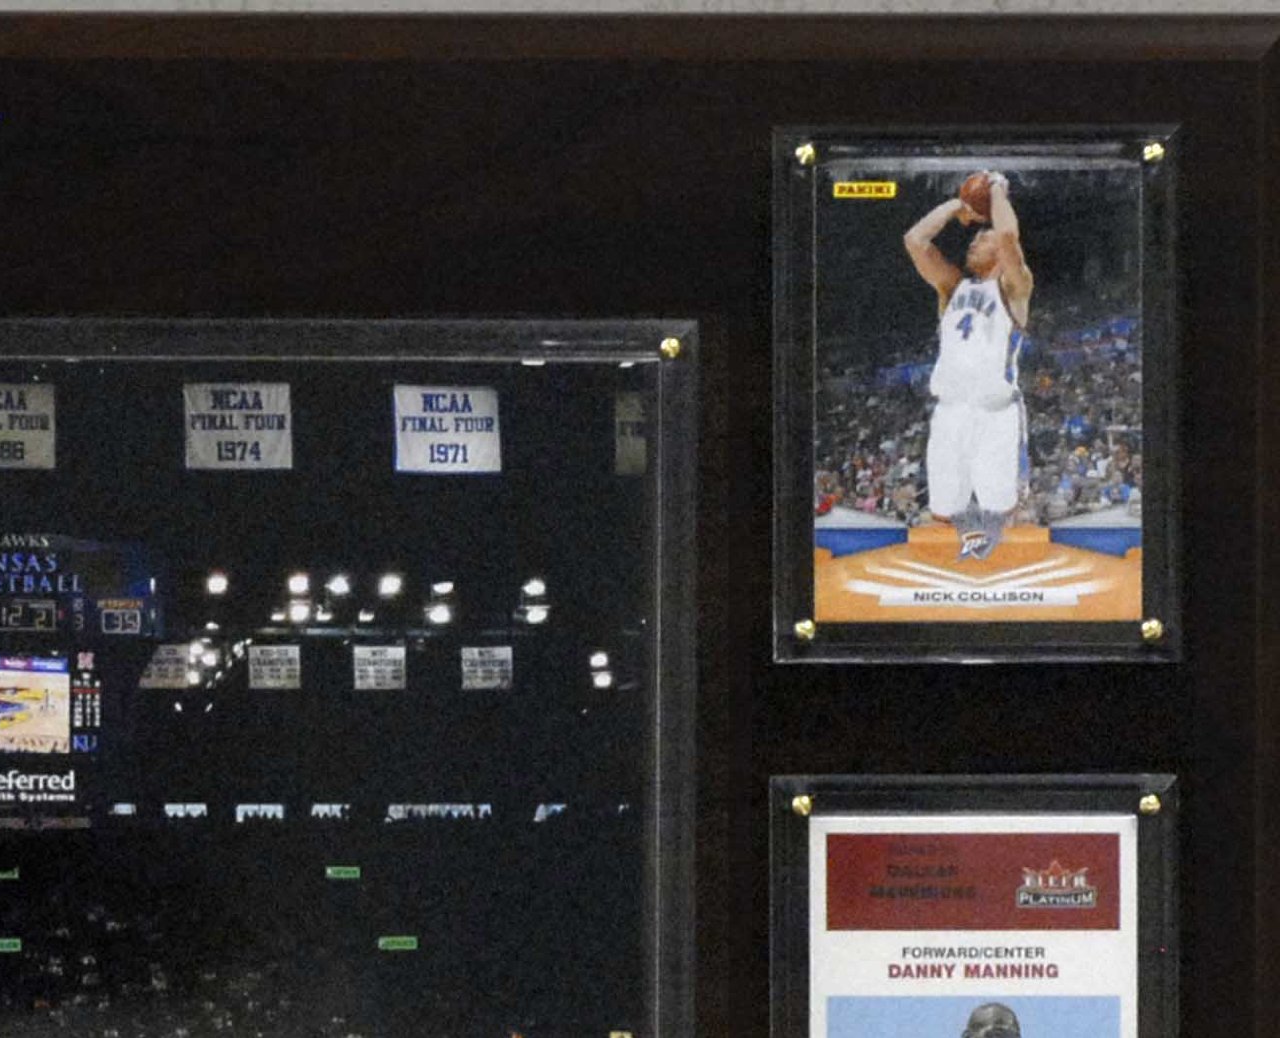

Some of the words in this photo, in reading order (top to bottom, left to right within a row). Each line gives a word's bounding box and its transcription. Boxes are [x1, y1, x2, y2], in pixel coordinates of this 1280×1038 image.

[837, 185, 891, 195] PANINI
[956, 313, 973, 339] 4
[211, 390, 263, 410] NCAA
[421, 394, 472, 412] NCAA
[7, 413, 49, 430] FOUR
[190, 414, 238, 430] FINAL
[245, 414, 286, 430] FOUR
[401, 416, 448, 432] FINAL
[454, 416, 494, 432] FOUR
[216, 441, 261, 461] 1974
[429, 444, 469, 463] 1971
[913, 592, 954, 601] NICK
[958, 592, 1044, 601] COLLISON
[901, 946, 1045, 959] FORWARD/CENTER
[887, 963, 956, 979] DANNY
[964, 963, 1059, 979] MANNING
